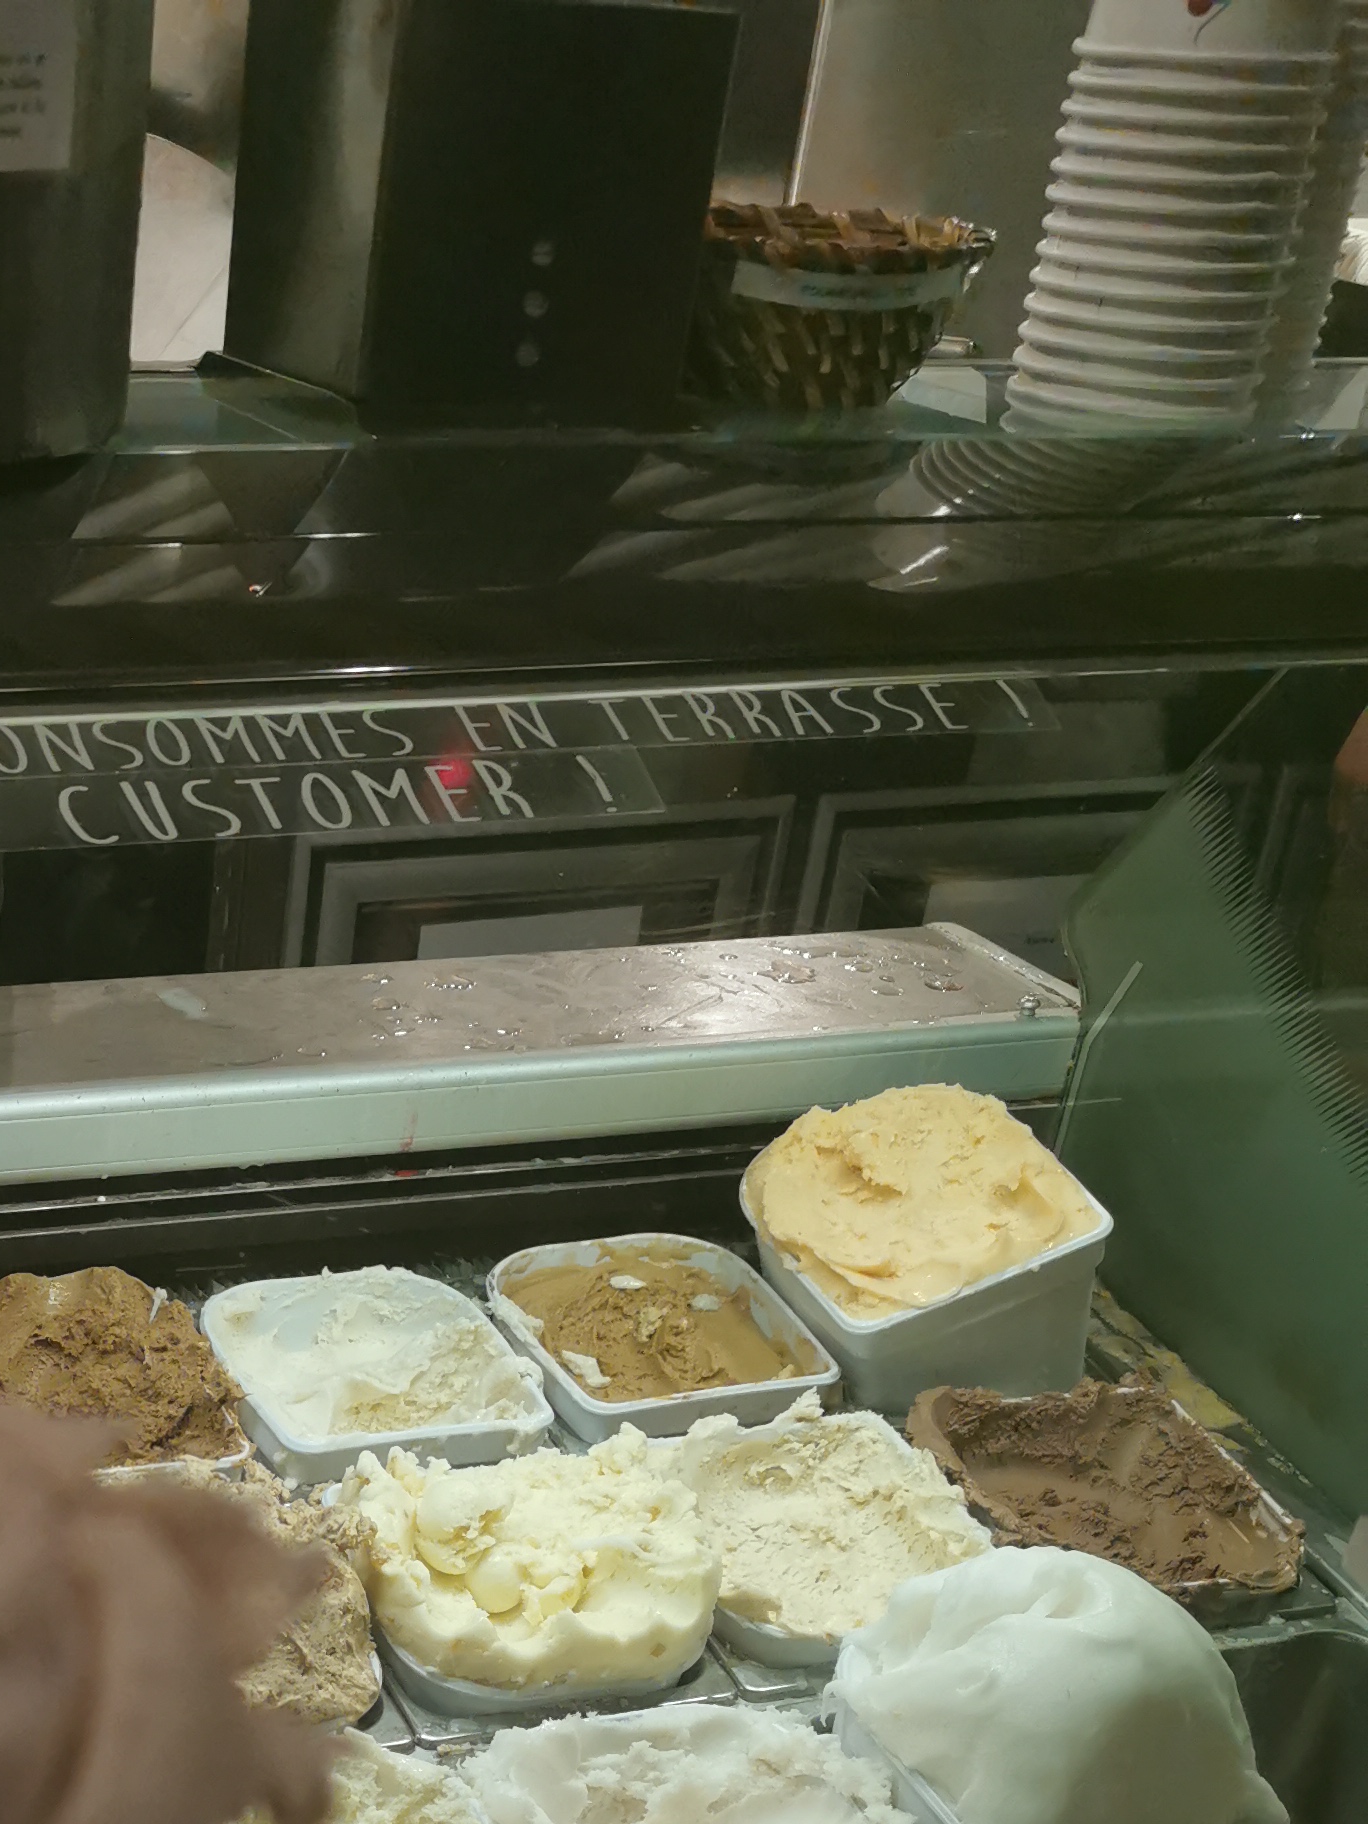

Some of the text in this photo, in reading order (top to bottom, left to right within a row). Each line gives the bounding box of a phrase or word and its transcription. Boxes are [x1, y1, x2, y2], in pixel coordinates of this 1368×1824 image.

[454, 700, 559, 752] EN
[588, 684, 969, 742] TERRASSE
[57, 757, 535, 845] CUSTOMER
[575, 754, 619, 814] !
